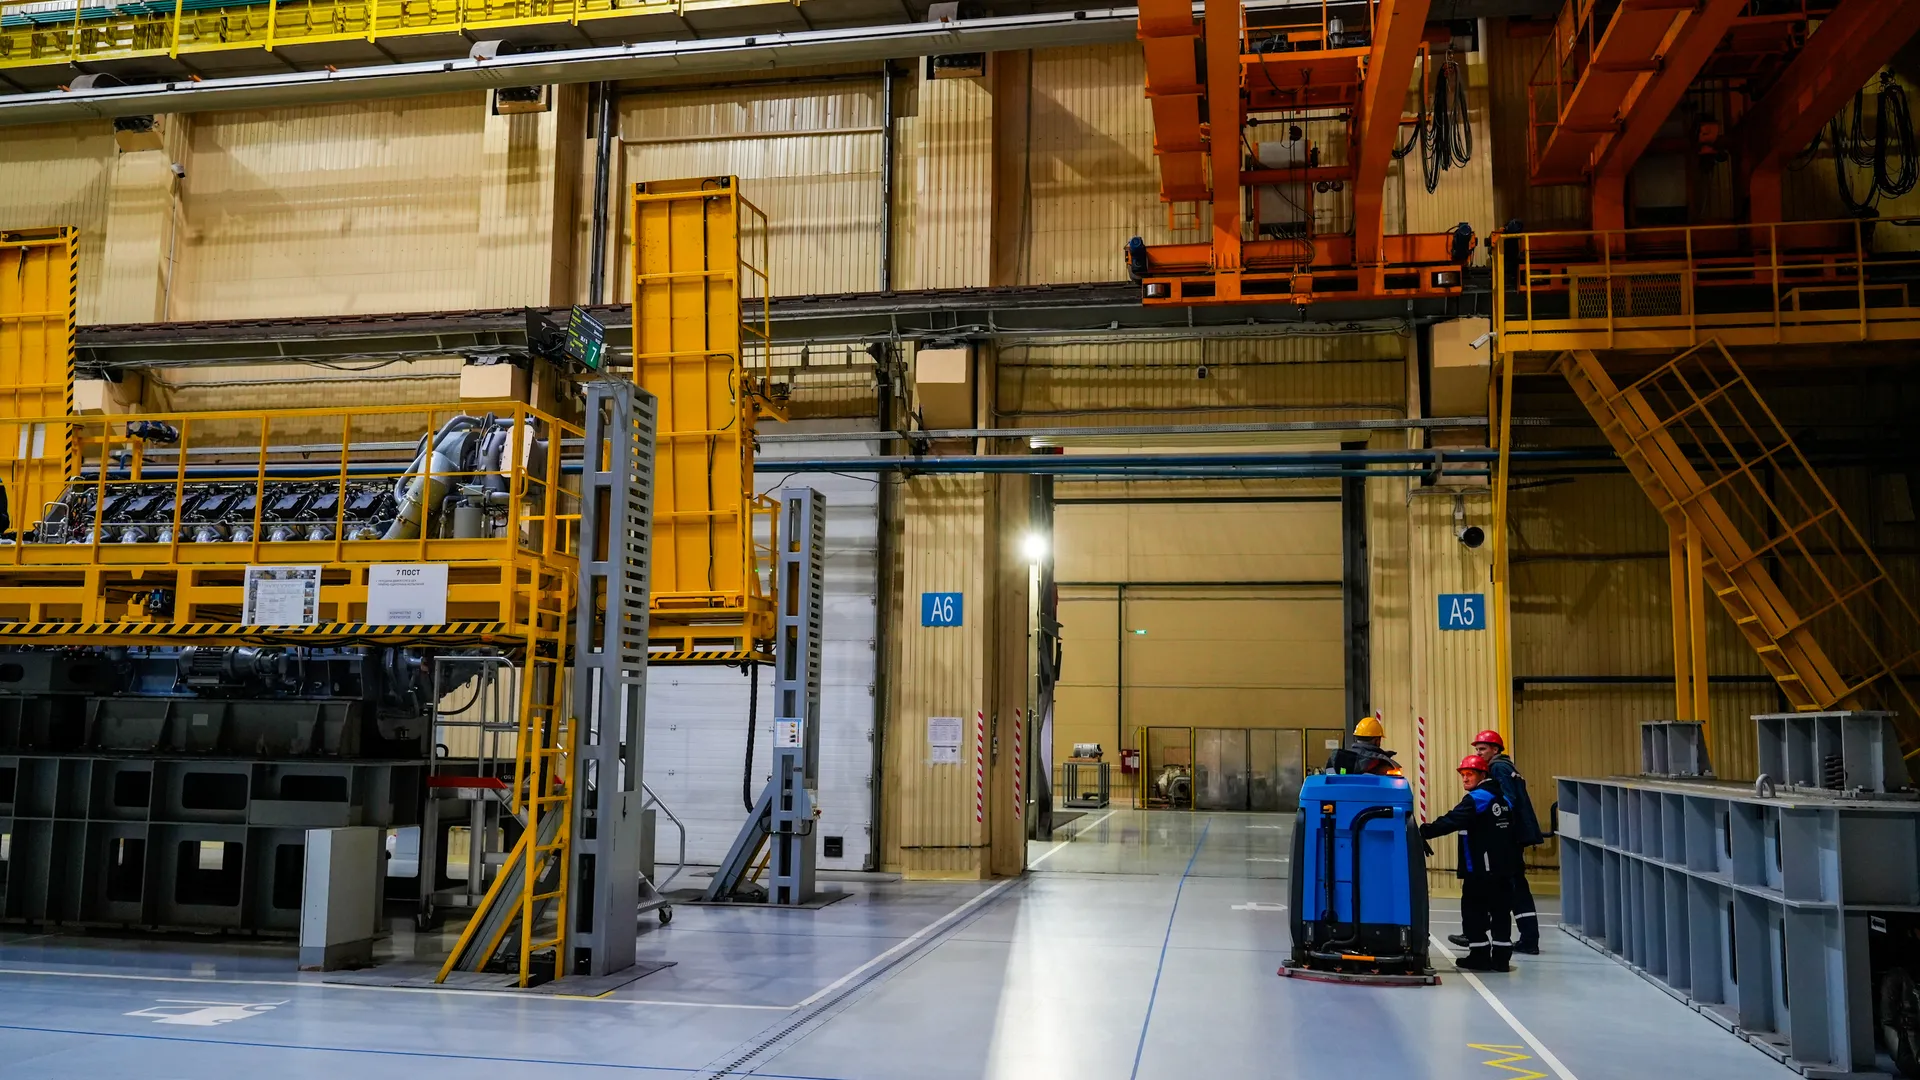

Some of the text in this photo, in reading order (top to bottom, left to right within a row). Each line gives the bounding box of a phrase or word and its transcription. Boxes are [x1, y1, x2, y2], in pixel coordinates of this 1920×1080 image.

[590, 346, 597, 362] 7
[416, 611, 422, 619] 3
[931, 596, 953, 622] A6
[1449, 598, 1474, 625] A5
